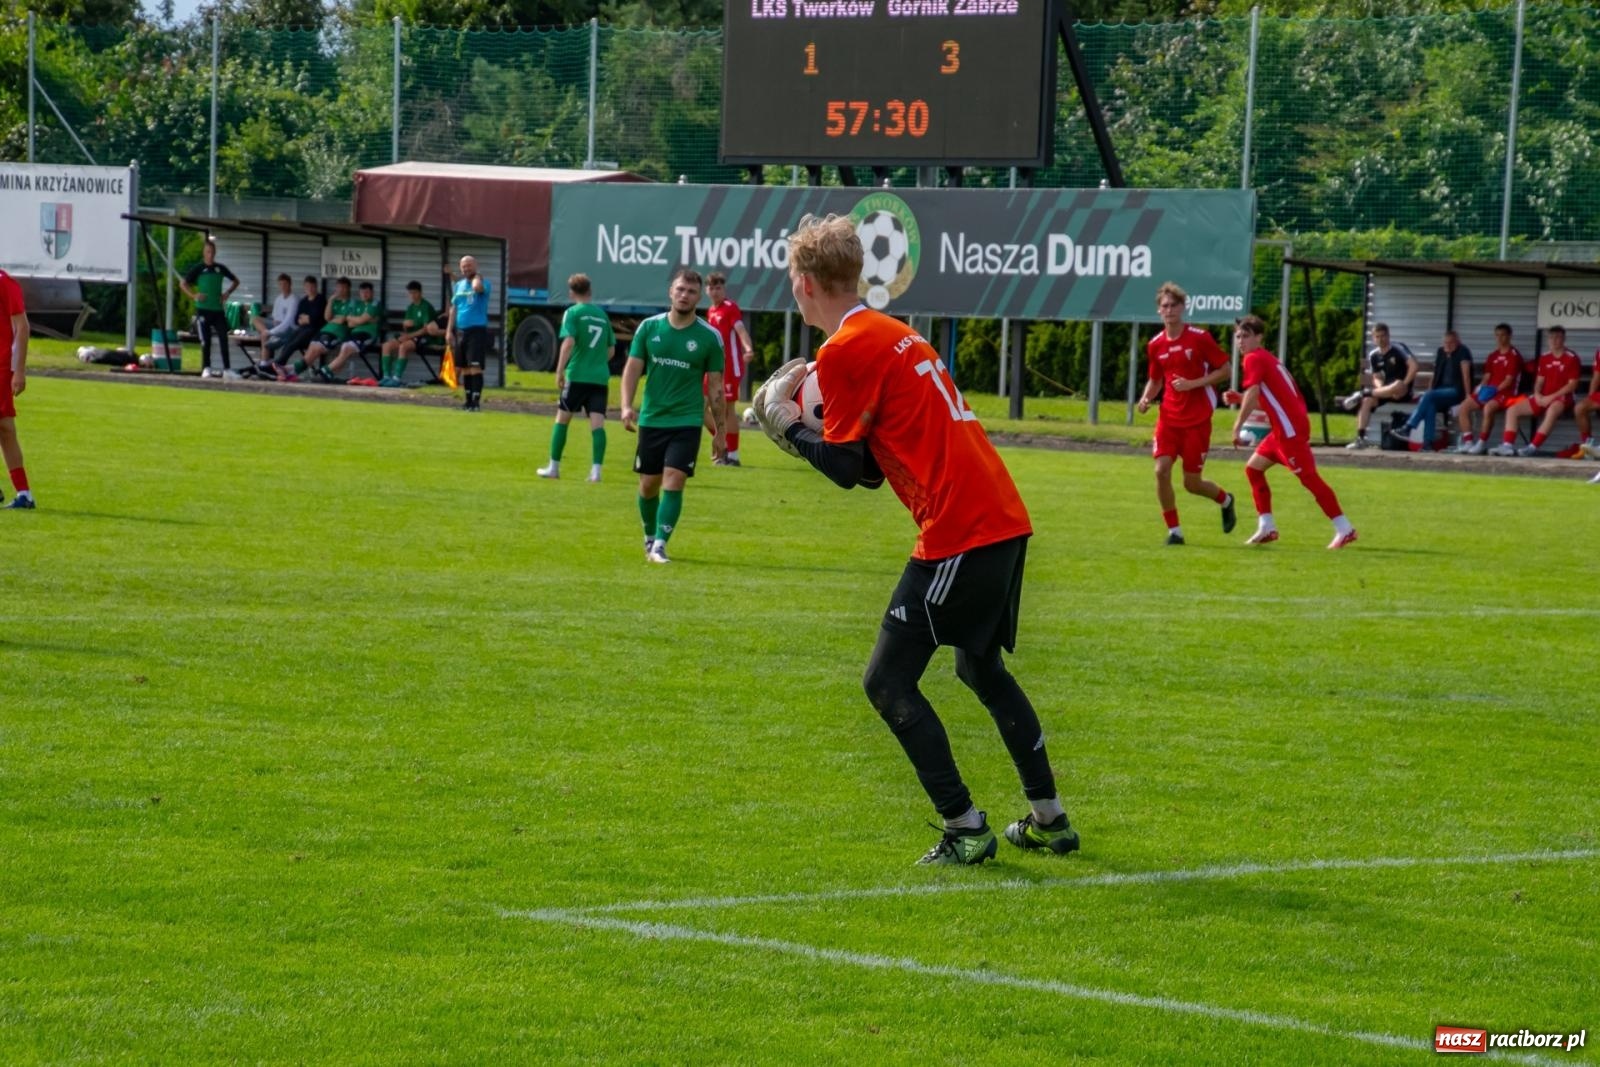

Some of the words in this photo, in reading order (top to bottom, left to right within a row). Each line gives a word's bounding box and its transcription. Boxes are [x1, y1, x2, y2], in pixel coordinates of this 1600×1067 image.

[752, 0, 787, 17] LKS
[953, 0, 1019, 14] Zabrze
[803, 42, 819, 75] 1
[940, 40, 960, 74] 3
[825, 100, 929, 137] 57:30
[35, 172, 123, 194] KRZYŻANOWICE
[342, 249, 361, 261] LKS
[597, 224, 668, 264] Nasz
[675, 226, 790, 269] Tworkó
[939, 232, 1039, 275] Nasza
[1047, 233, 1152, 277] Duma
[1550, 297, 1600, 318] GOŚC
[588, 324, 603, 348] 7
[893, 336, 913, 354] LKS
[914, 358, 977, 421] 12
